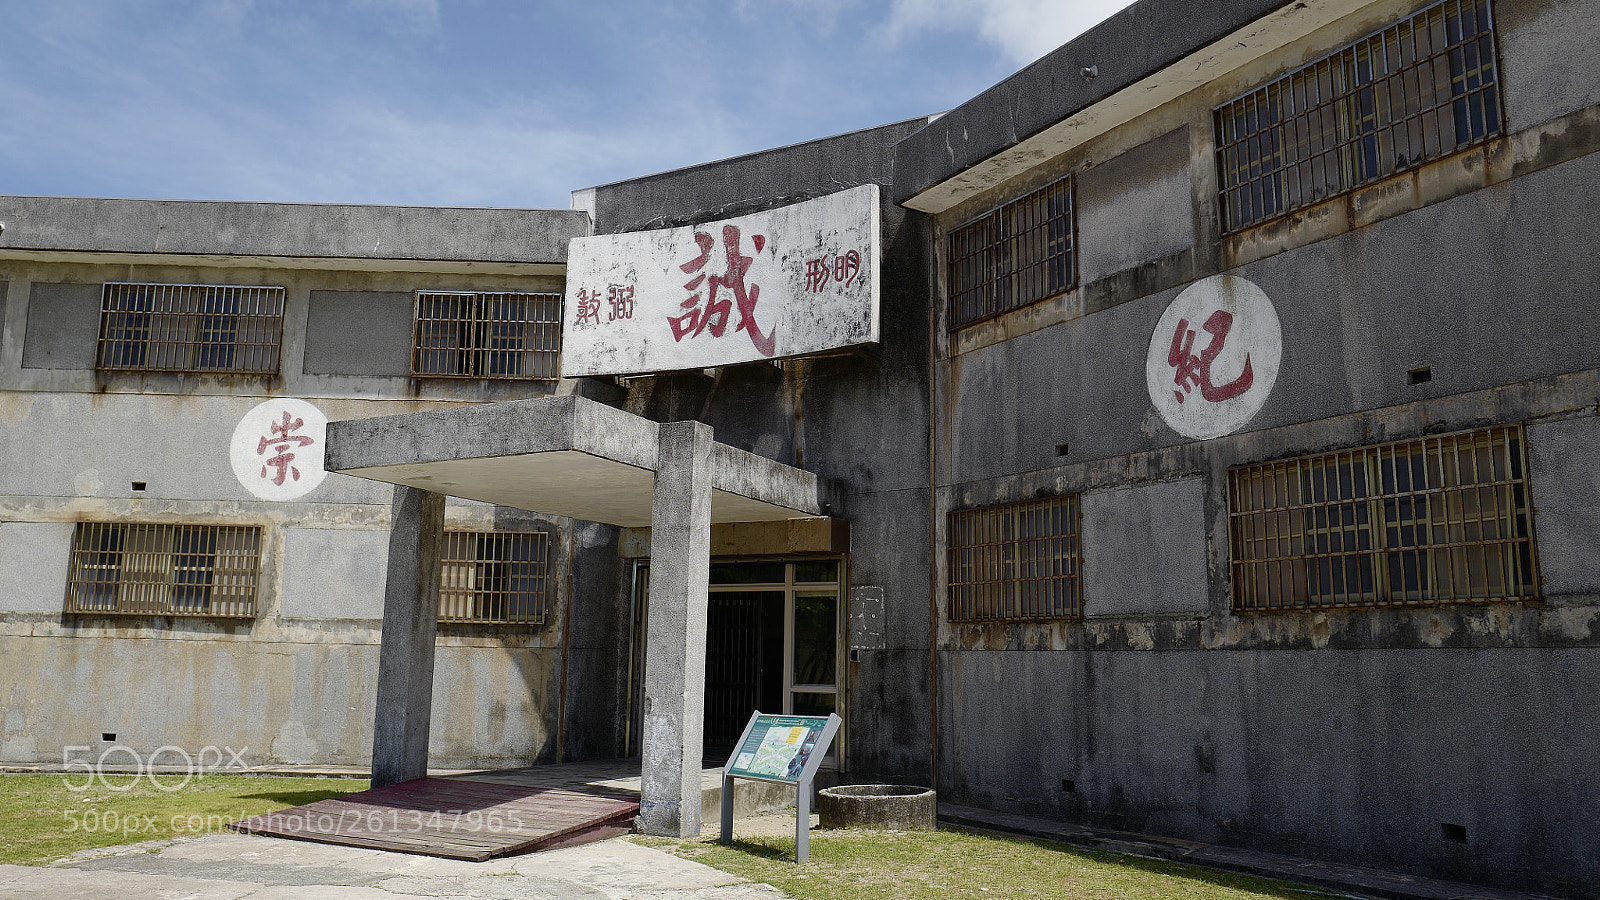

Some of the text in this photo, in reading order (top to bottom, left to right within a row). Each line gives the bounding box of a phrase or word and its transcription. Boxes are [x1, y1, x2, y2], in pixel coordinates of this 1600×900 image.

[666, 225, 777, 358] 誠
[1167, 309, 1254, 405] 紀
[256, 410, 315, 487] 崇
